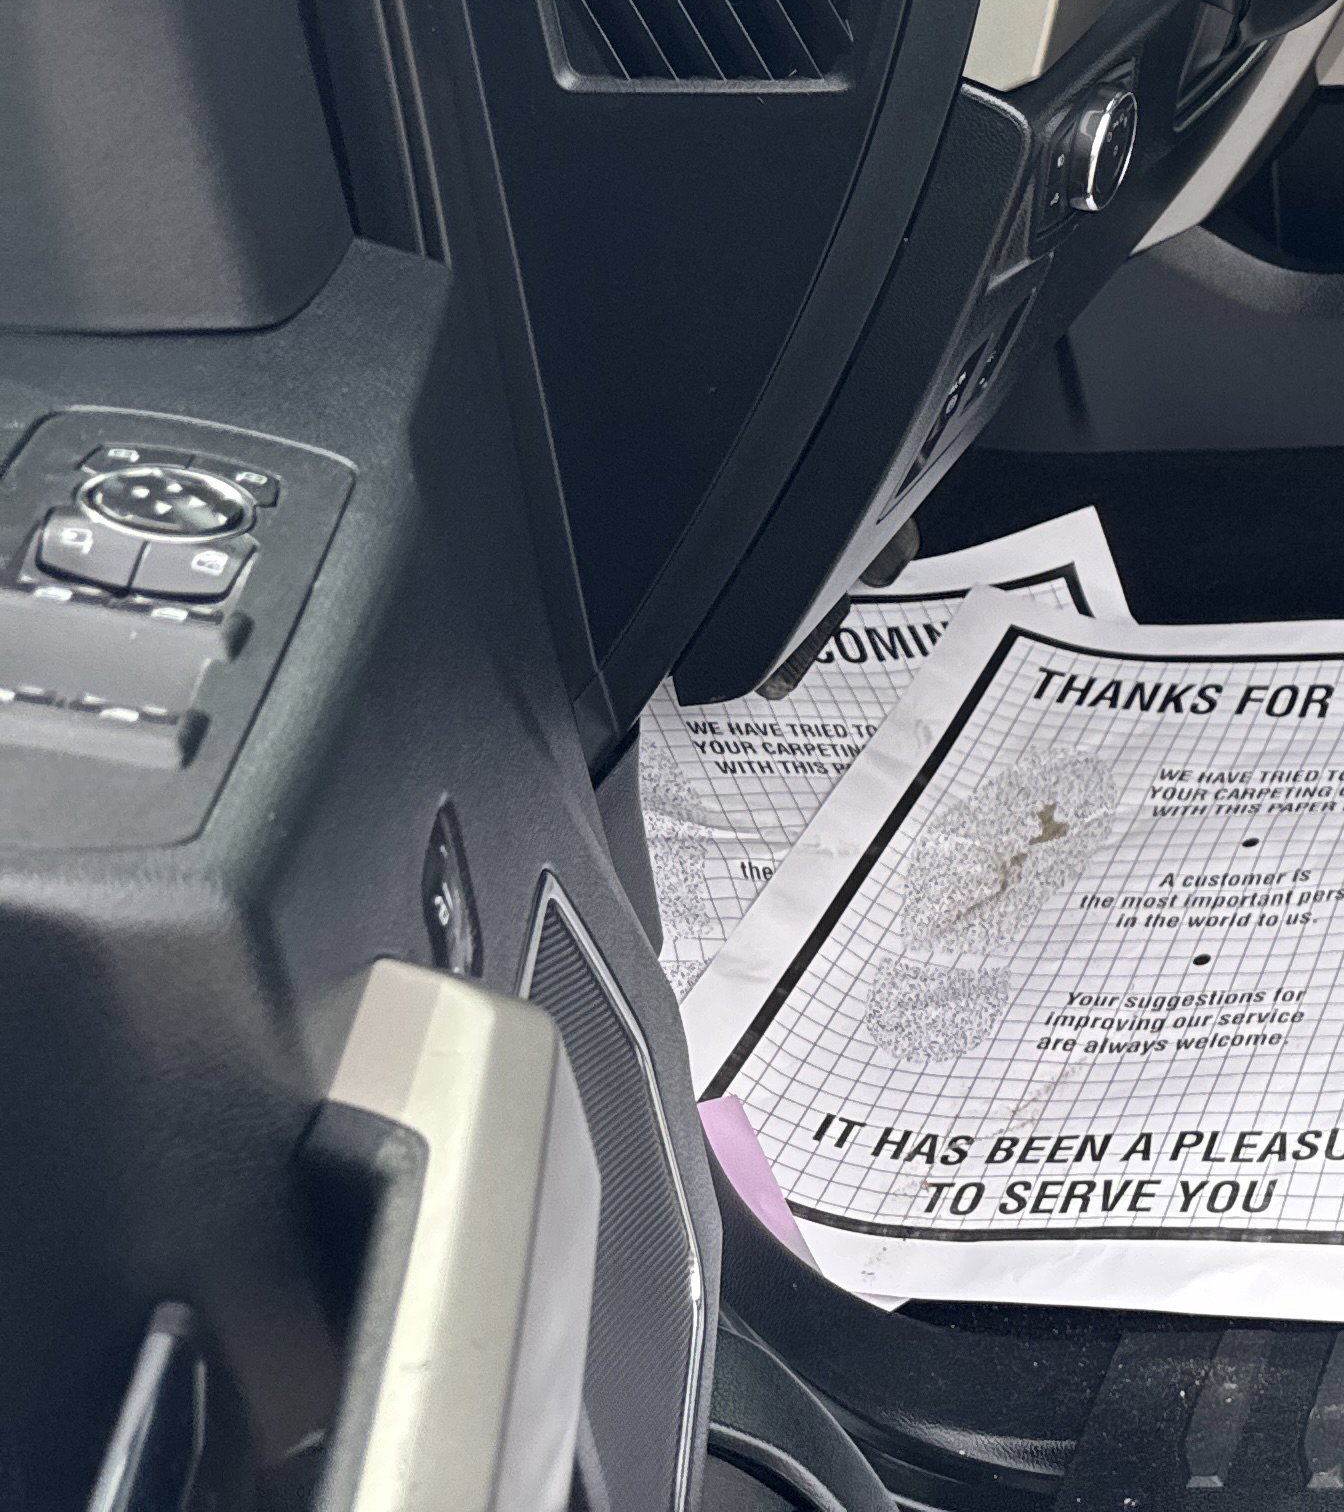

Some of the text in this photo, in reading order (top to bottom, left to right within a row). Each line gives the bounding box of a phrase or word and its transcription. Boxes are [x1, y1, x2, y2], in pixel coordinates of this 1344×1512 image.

[1033, 667, 1223, 715] THANKS
[1235, 684, 1335, 718] FOR
[686, 721, 878, 738] WE HAVE TRIED TO
[693, 740, 867, 758] YOUR CARPETIN
[715, 760, 775, 775] WITH
[777, 761, 828, 775] THIS
[1159, 768, 1194, 783] WE
[1197, 769, 1252, 784] HAVE
[1259, 769, 1319, 783] TRIED
[1149, 785, 1208, 801] YOUR
[1214, 786, 1334, 800] CARPETING
[1152, 804, 1208, 817] WITH
[1214, 802, 1260, 816] THIS
[1267, 800, 1337, 814] PAPER
[740, 861, 774, 880] the
[1159, 868, 1312, 888] A customer is
[1079, 894, 1115, 909] the
[1120, 894, 1178, 908] most
[1183, 890, 1293, 912] important
[1115, 910, 1318, 928] in the world to us.
[1066, 989, 1307, 1012] Your suggestions for
[1044, 1009, 1305, 1034] improving our service
[1036, 1032, 1289, 1056] are always welcome.
[812, 1113, 867, 1149] IT
[870, 1126, 975, 1166] HAS
[985, 1133, 1113, 1164] BEEN
[1120, 1131, 1153, 1162] A
[923, 1178, 1278, 1215] TO SERVE YOU
